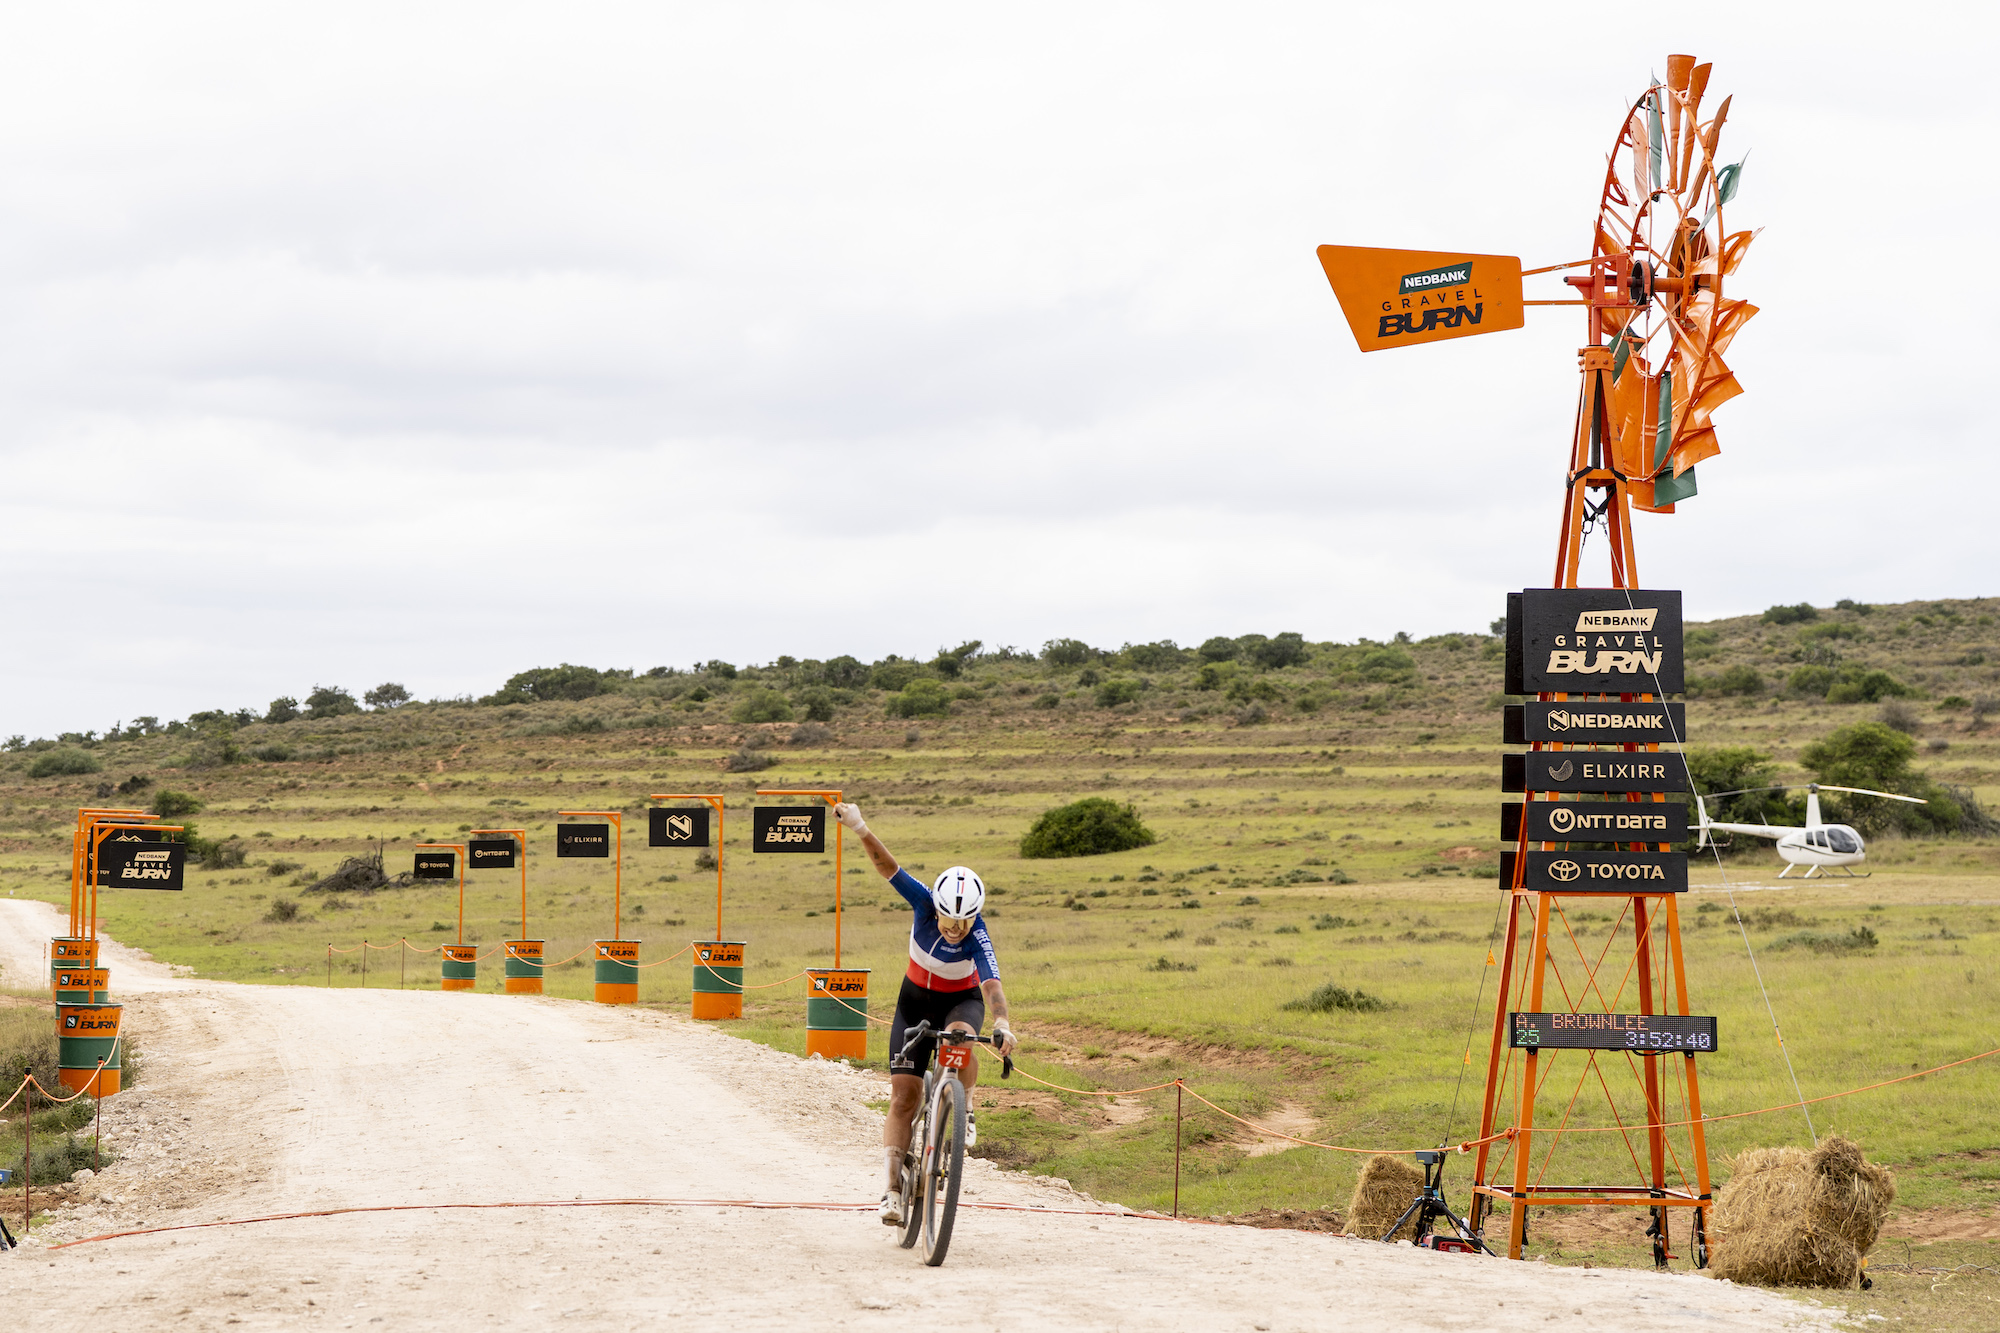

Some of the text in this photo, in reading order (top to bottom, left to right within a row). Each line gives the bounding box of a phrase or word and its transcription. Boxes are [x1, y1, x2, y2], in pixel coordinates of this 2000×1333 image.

[1404, 270, 1467, 288] NEDBANK
[1381, 288, 1482, 312] GRAVEL
[1377, 302, 1483, 338] BURN
[1584, 616, 1648, 626] NEDBANK
[1554, 635, 1663, 648] GRAVEL
[1546, 650, 1663, 674] BURN
[1570, 714, 1664, 729] NEDBANK
[1583, 764, 1665, 779] ELIXIRR
[765, 832, 813, 843] BURN
[125, 861, 172, 869] GRAVEL
[1587, 863, 1665, 880] TOYOTA
[121, 868, 171, 880] BURN
[713, 954, 741, 962] BURN
[829, 983, 864, 992] BURN
[81, 1020, 117, 1029] BURN
[1516, 1013, 1649, 1031] A. BROWNLEE
[1516, 1029, 1711, 1048] 25 3:52:40
[945, 1055, 963, 1067] 74
